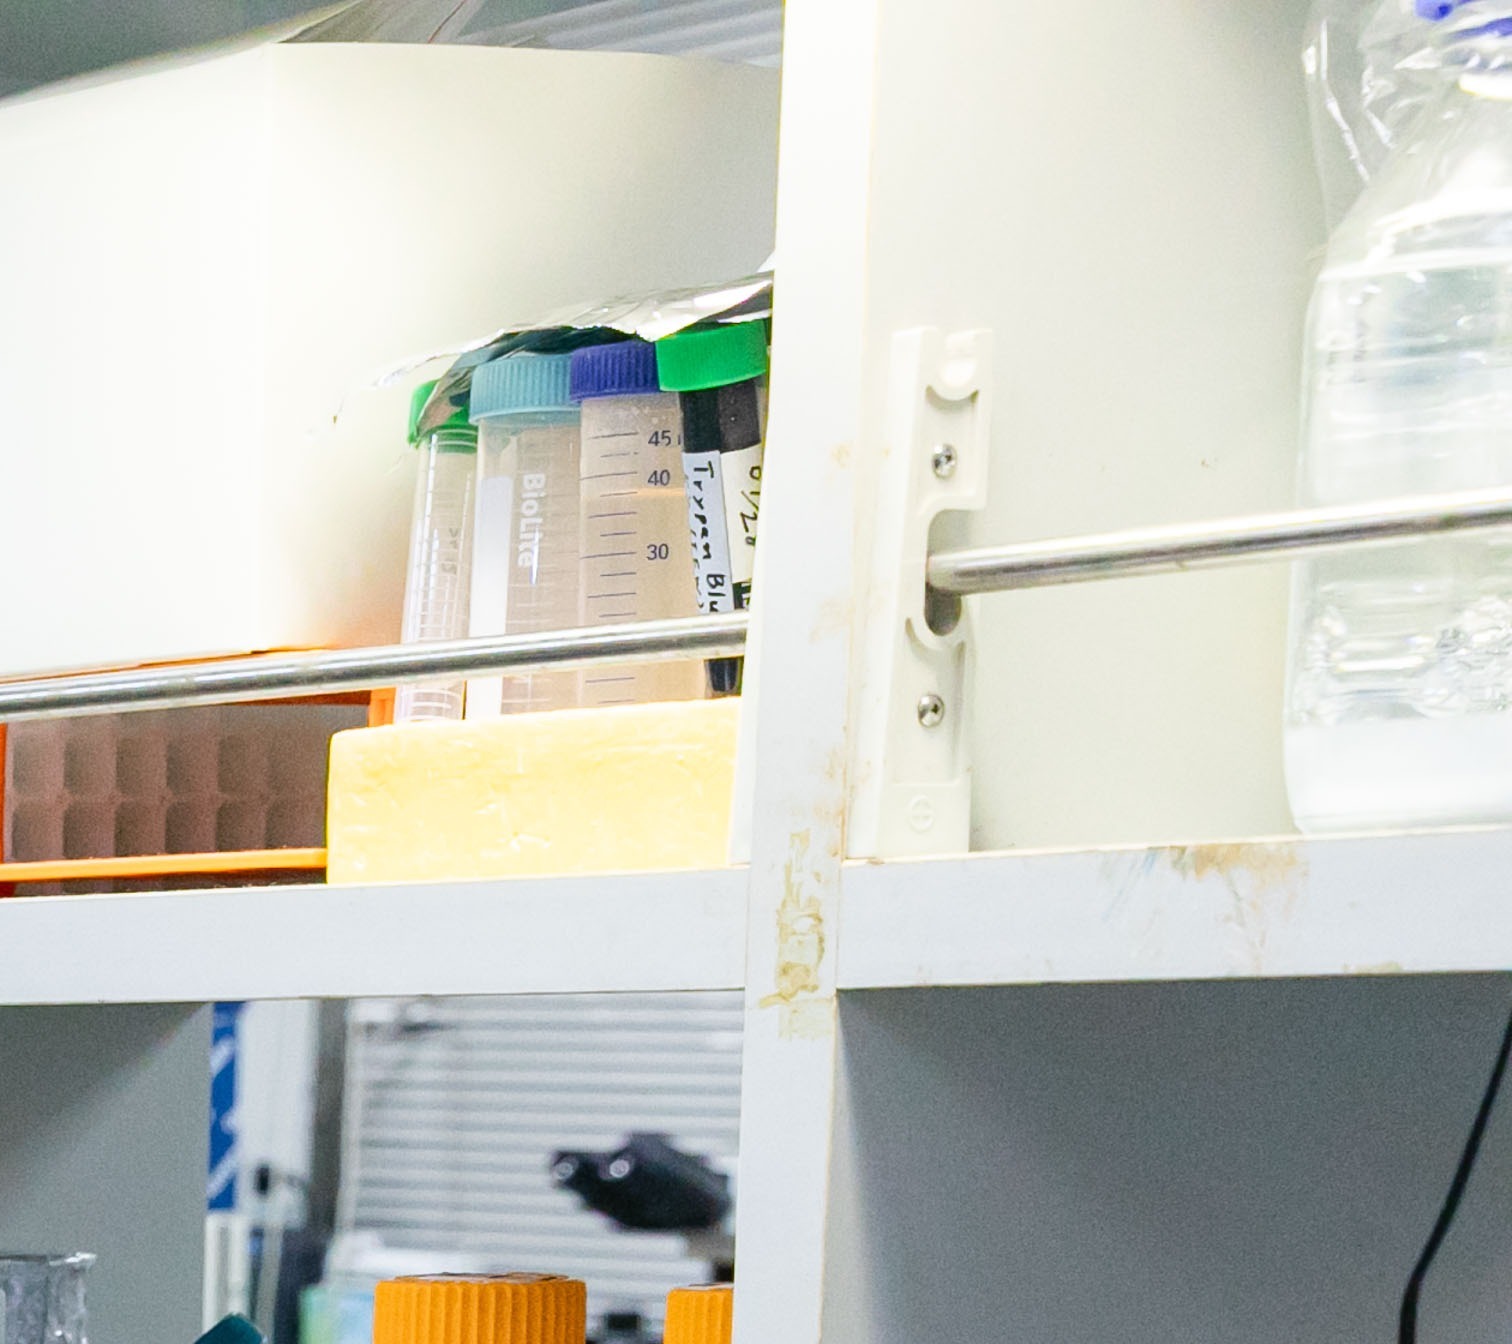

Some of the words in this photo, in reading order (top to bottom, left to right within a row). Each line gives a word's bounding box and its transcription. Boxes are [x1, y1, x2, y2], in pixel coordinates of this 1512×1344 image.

[648, 430, 672, 447] 45
[647, 468, 671, 487] 40
[646, 543, 670, 561] 30
